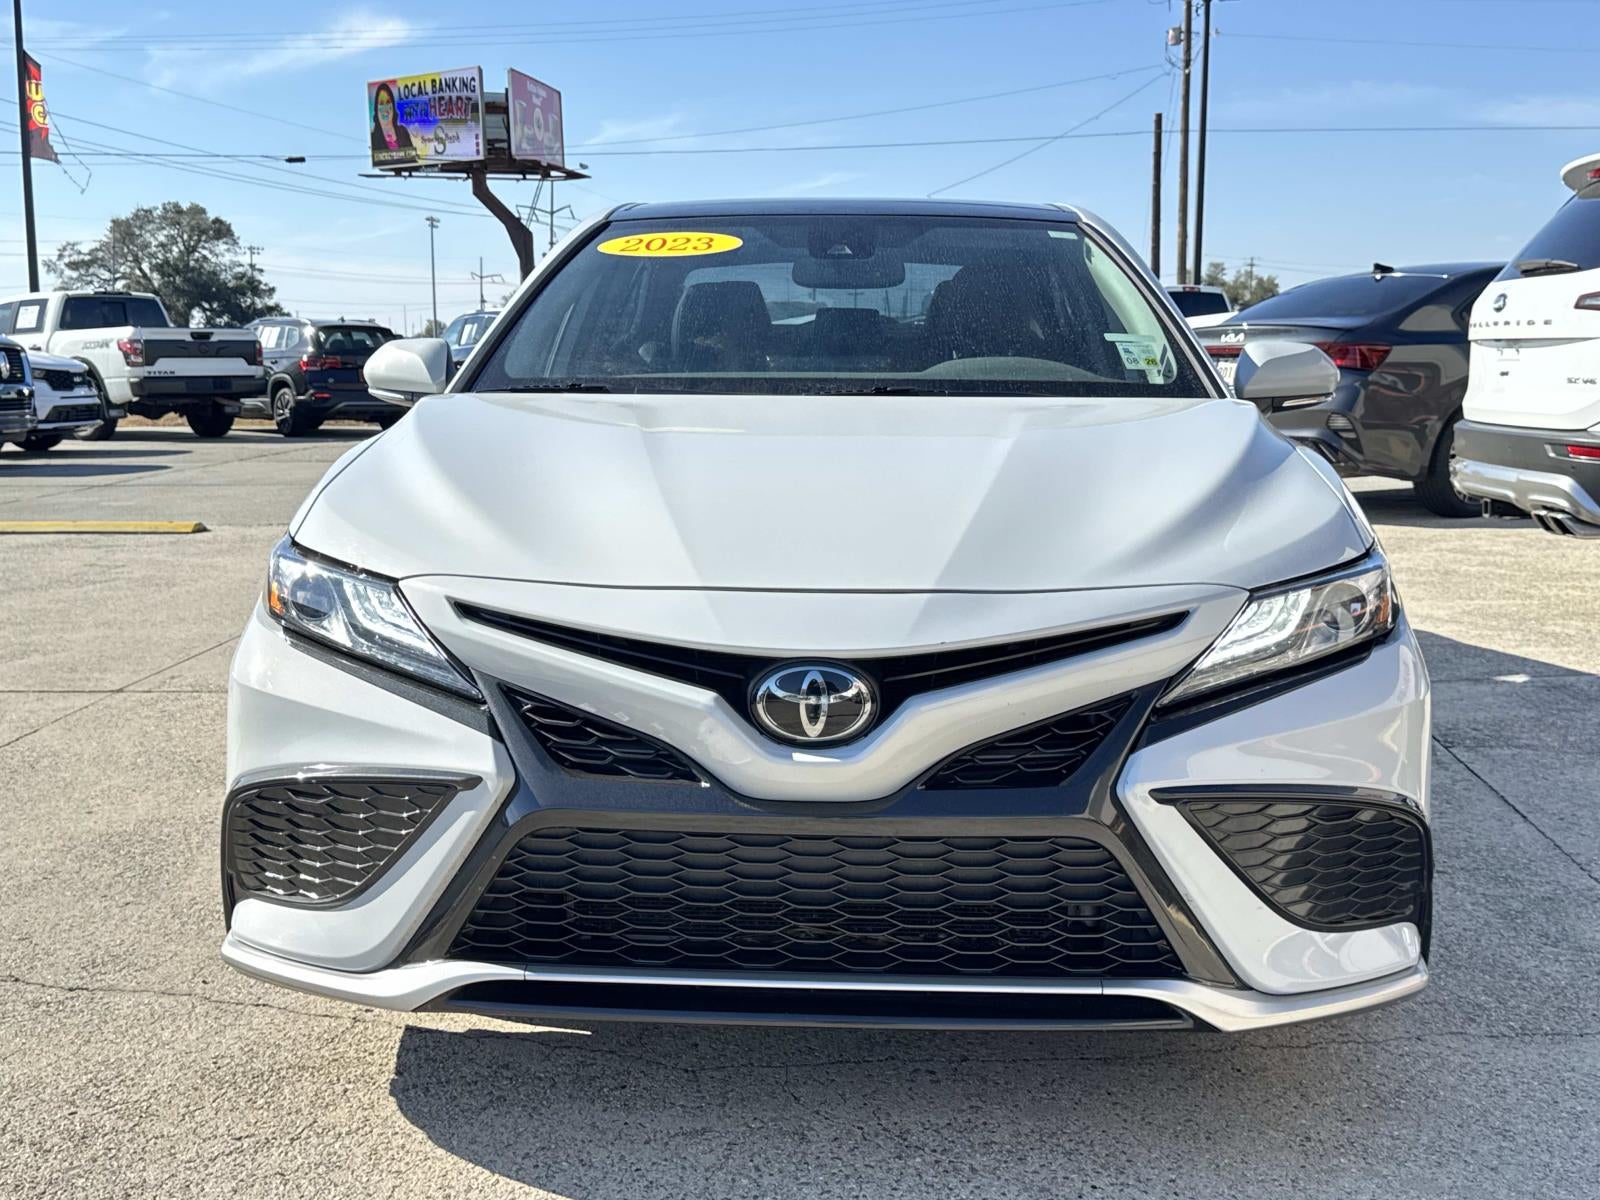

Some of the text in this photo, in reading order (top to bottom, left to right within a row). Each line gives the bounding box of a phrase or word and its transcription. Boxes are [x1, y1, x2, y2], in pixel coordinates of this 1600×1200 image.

[398, 76, 476, 100] LOCAL BANKING
[429, 95, 473, 118] HEART
[619, 237, 714, 252] 2023
[1220, 332, 1245, 343] KIA
